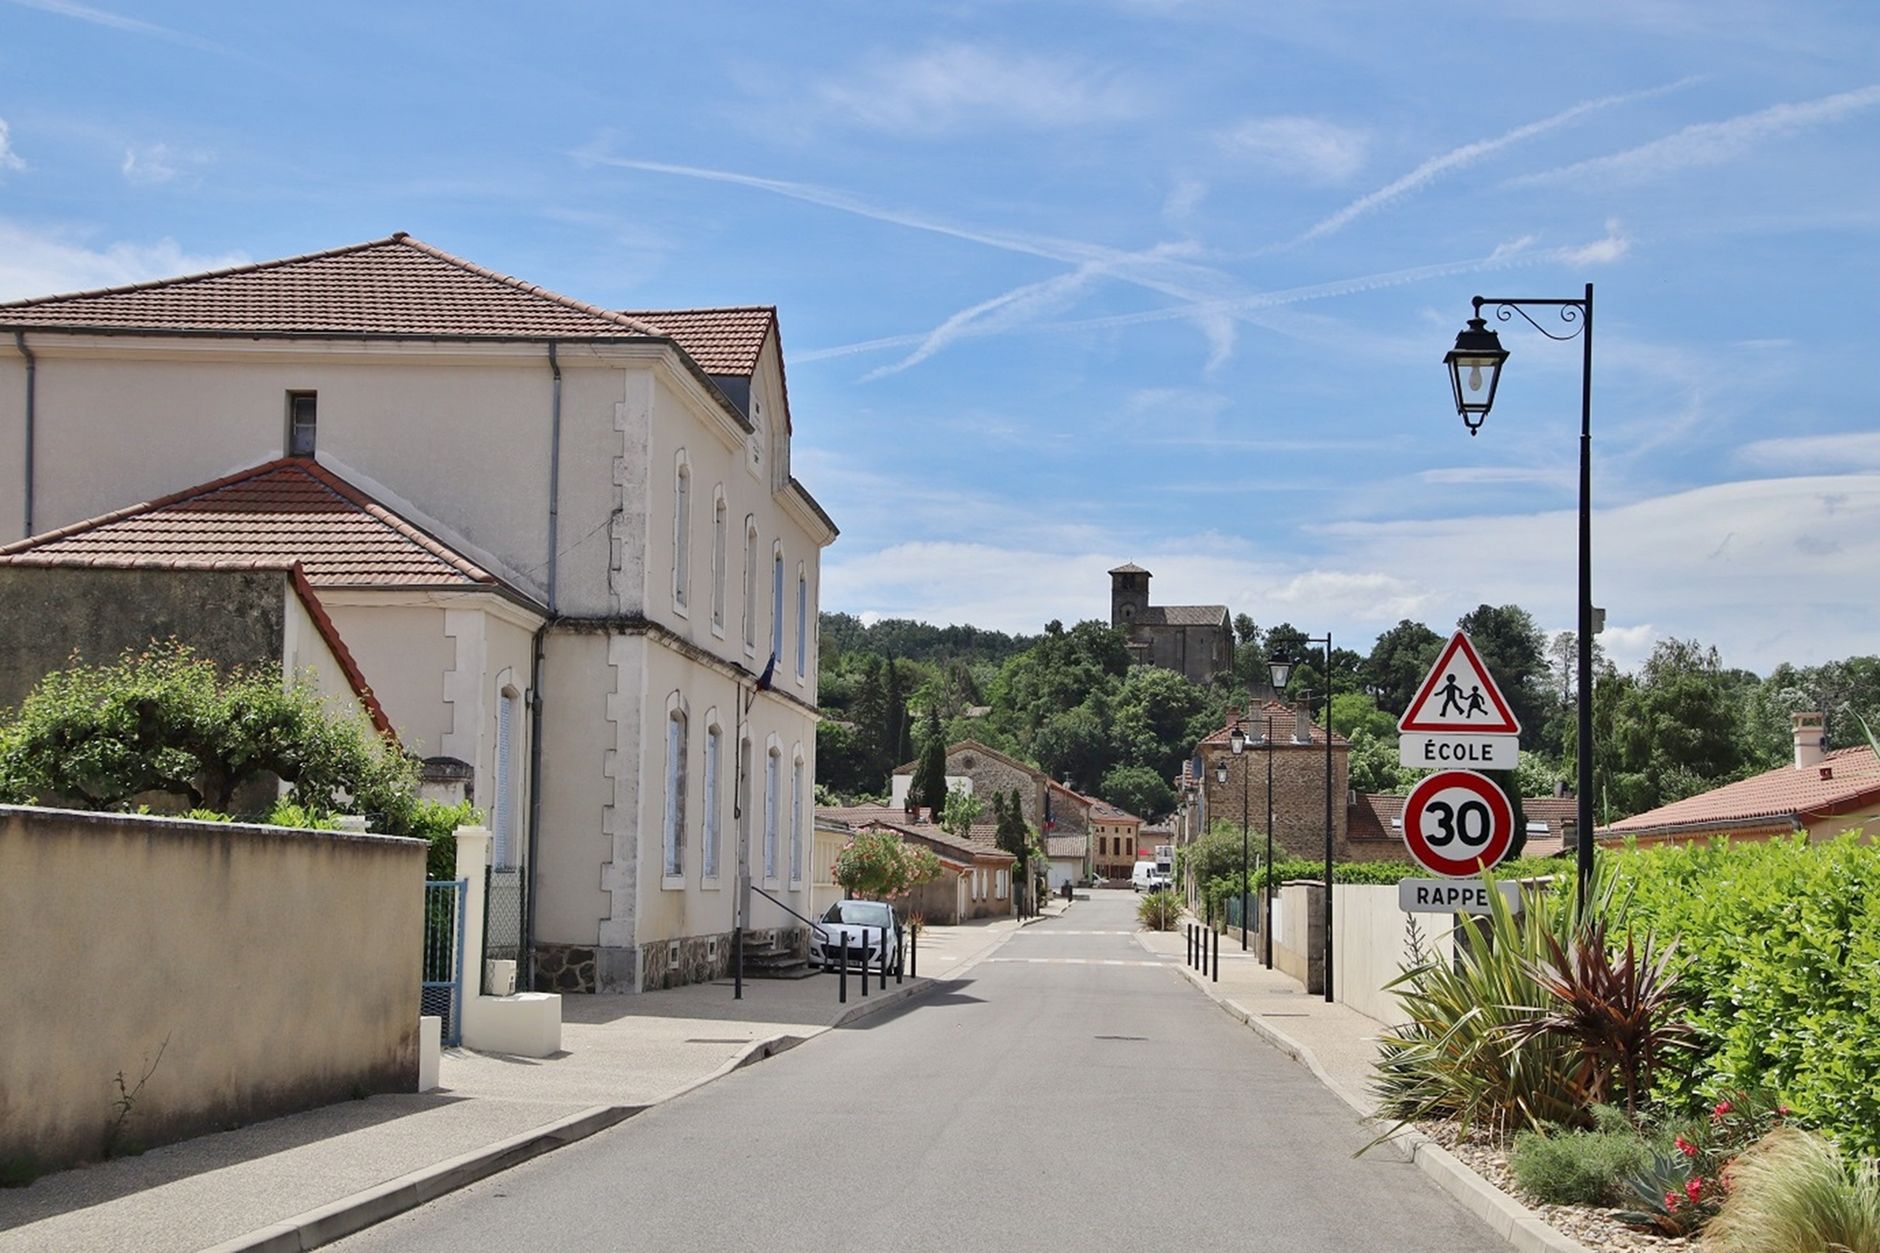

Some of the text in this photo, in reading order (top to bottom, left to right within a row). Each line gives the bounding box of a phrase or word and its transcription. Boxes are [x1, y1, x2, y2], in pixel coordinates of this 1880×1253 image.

[1424, 738, 1493, 761] ÉCOLE
[1425, 800, 1491, 847] 30
[1417, 886, 1492, 906] RAPPE
